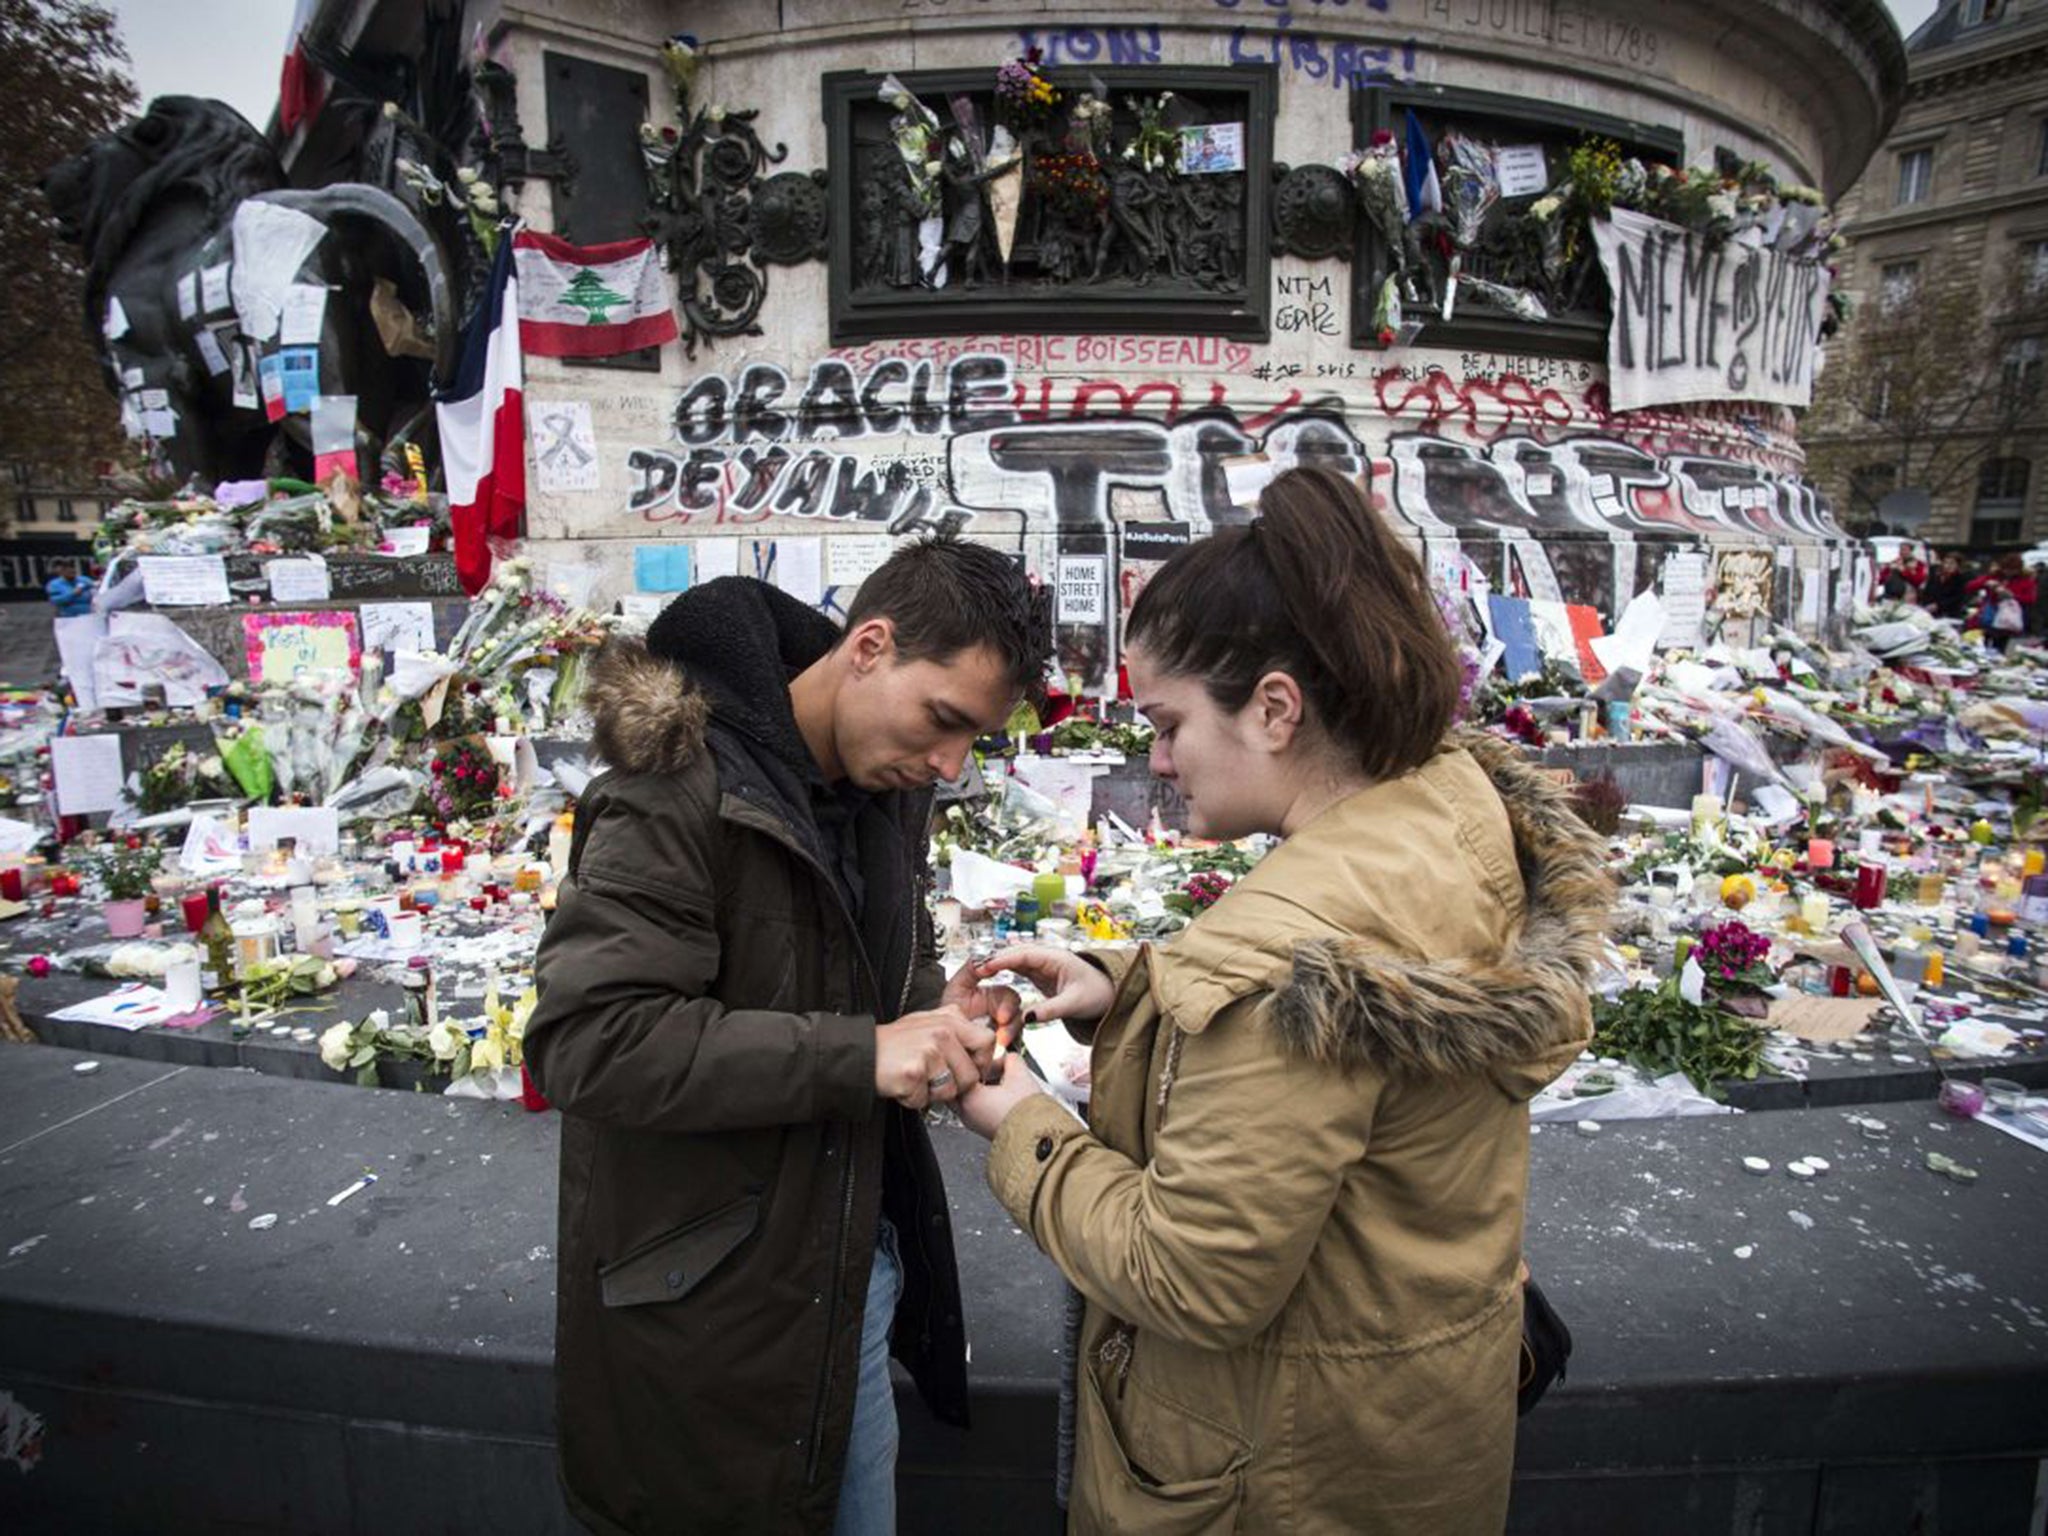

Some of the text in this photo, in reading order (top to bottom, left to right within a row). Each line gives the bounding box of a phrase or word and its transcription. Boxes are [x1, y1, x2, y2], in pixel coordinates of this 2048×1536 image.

[1464, 0, 1597, 47] JUILLET
[1603, 18, 1658, 66] 1789
[1277, 276, 1331, 301] NTM
[1076, 335, 1220, 367] BOISSEAU
[1461, 353, 1480, 370] BE
[1487, 355, 1496, 369] A
[1065, 566, 1096, 580] HOME
[1060, 582, 1101, 597] STREET
[1064, 598, 1096, 613] HOME
